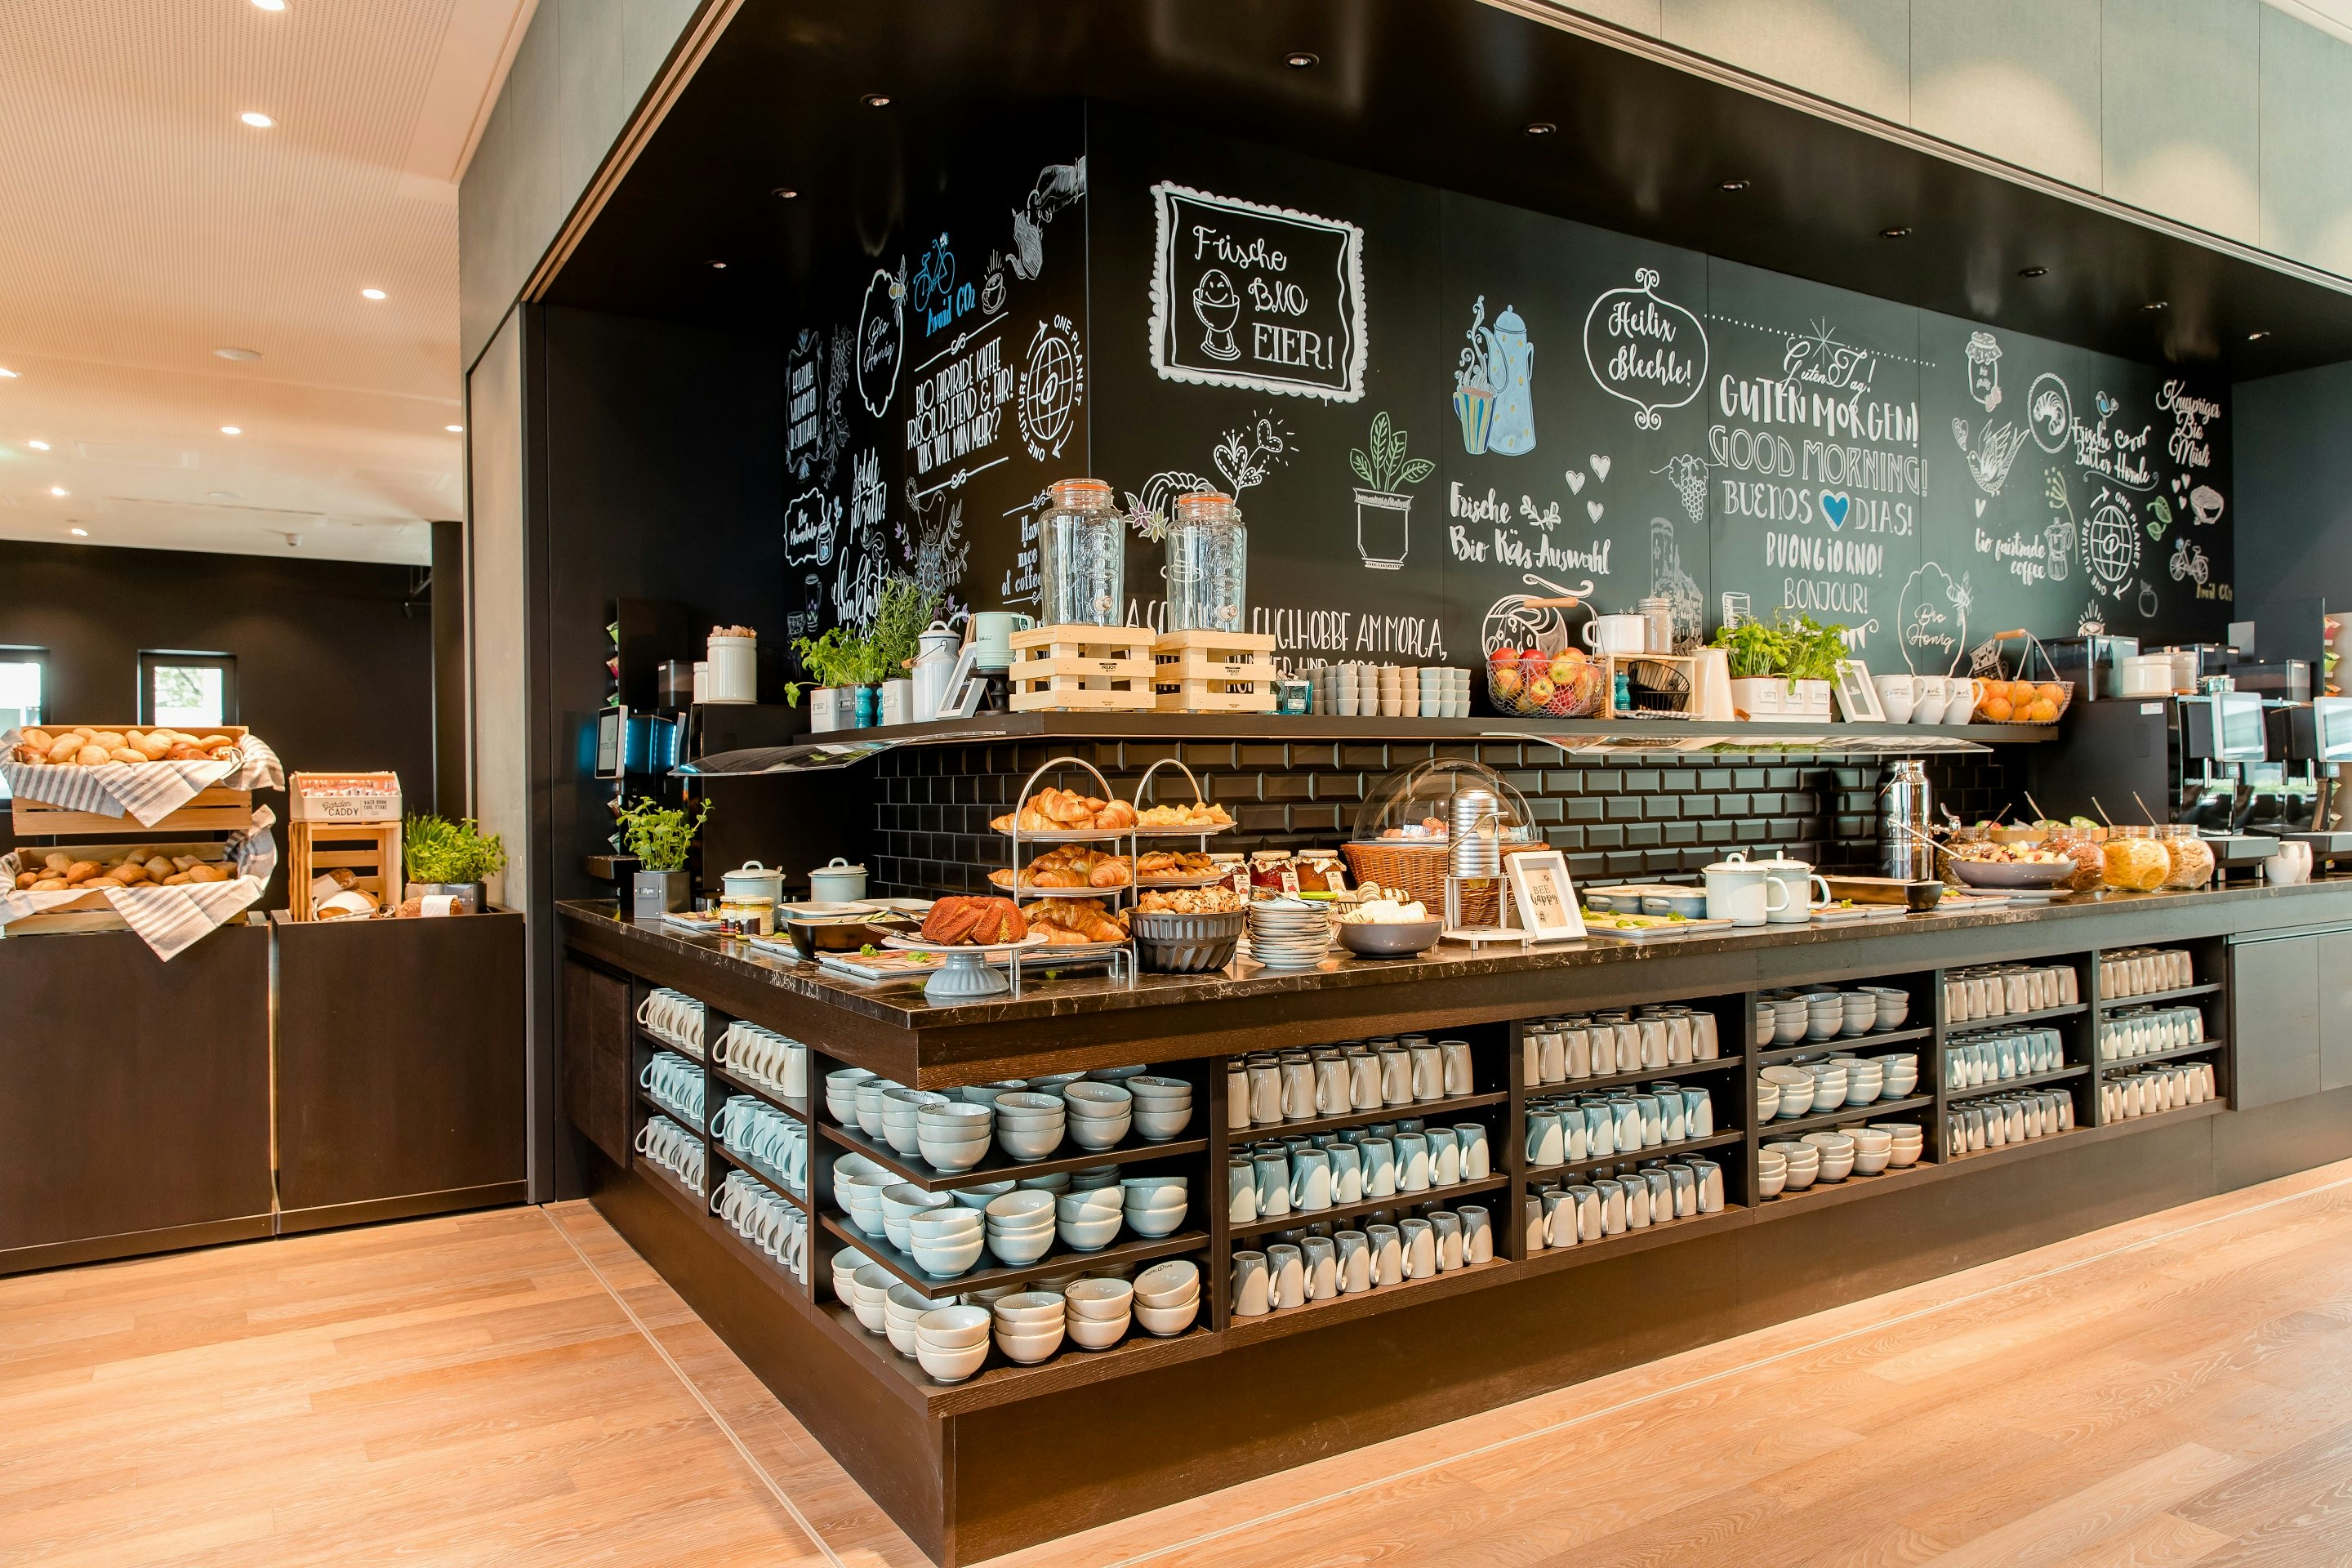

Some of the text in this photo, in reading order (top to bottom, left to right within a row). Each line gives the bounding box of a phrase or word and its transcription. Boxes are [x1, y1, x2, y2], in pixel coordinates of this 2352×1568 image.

[1192, 225, 1287, 271] Frische
[926, 295, 952, 337] Avoid
[1248, 278, 1308, 316] BIO
[1608, 301, 1676, 342] Heilix
[1054, 314, 1084, 407] ONE PLANET
[1252, 322, 1333, 370] EIER!
[1608, 343, 1691, 388] Blechle!
[915, 336, 1001, 416] BIO FAIRTRADE KAFFEE
[1775, 336, 1877, 412] Guten Tag!
[939, 387, 978, 434] DUFTEND
[980, 380, 991, 412] &
[993, 364, 1013, 407] FAIR!
[1018, 372, 1046, 462] ONE FUTURE
[1720, 374, 1919, 448] GUTEN MORGEN!
[916, 407, 1002, 474] WAS WILL MAN MEHR?
[1708, 425, 1928, 497] GOOD MORNING!
[2075, 439, 2113, 475] Butter
[1450, 481, 1511, 523] Frische
[1722, 479, 1913, 536] BUENOS DIAS!
[1021, 514, 1040, 544] Hav
[1450, 525, 1490, 563] Bio
[2114, 492, 2141, 569] ONE PLANET
[1018, 547, 1038, 569] nice
[2010, 559, 2046, 586] coffee
[2081, 518, 2108, 596] ONE FUTURE
[1002, 569, 1011, 596] of
[1784, 577, 1869, 614] BONJOUR!
[1356, 613, 1383, 653] AM
[328, 808, 359, 817] CADDY
[1530, 893, 1559, 906] happy
[1533, 884, 1551, 895] BEE
